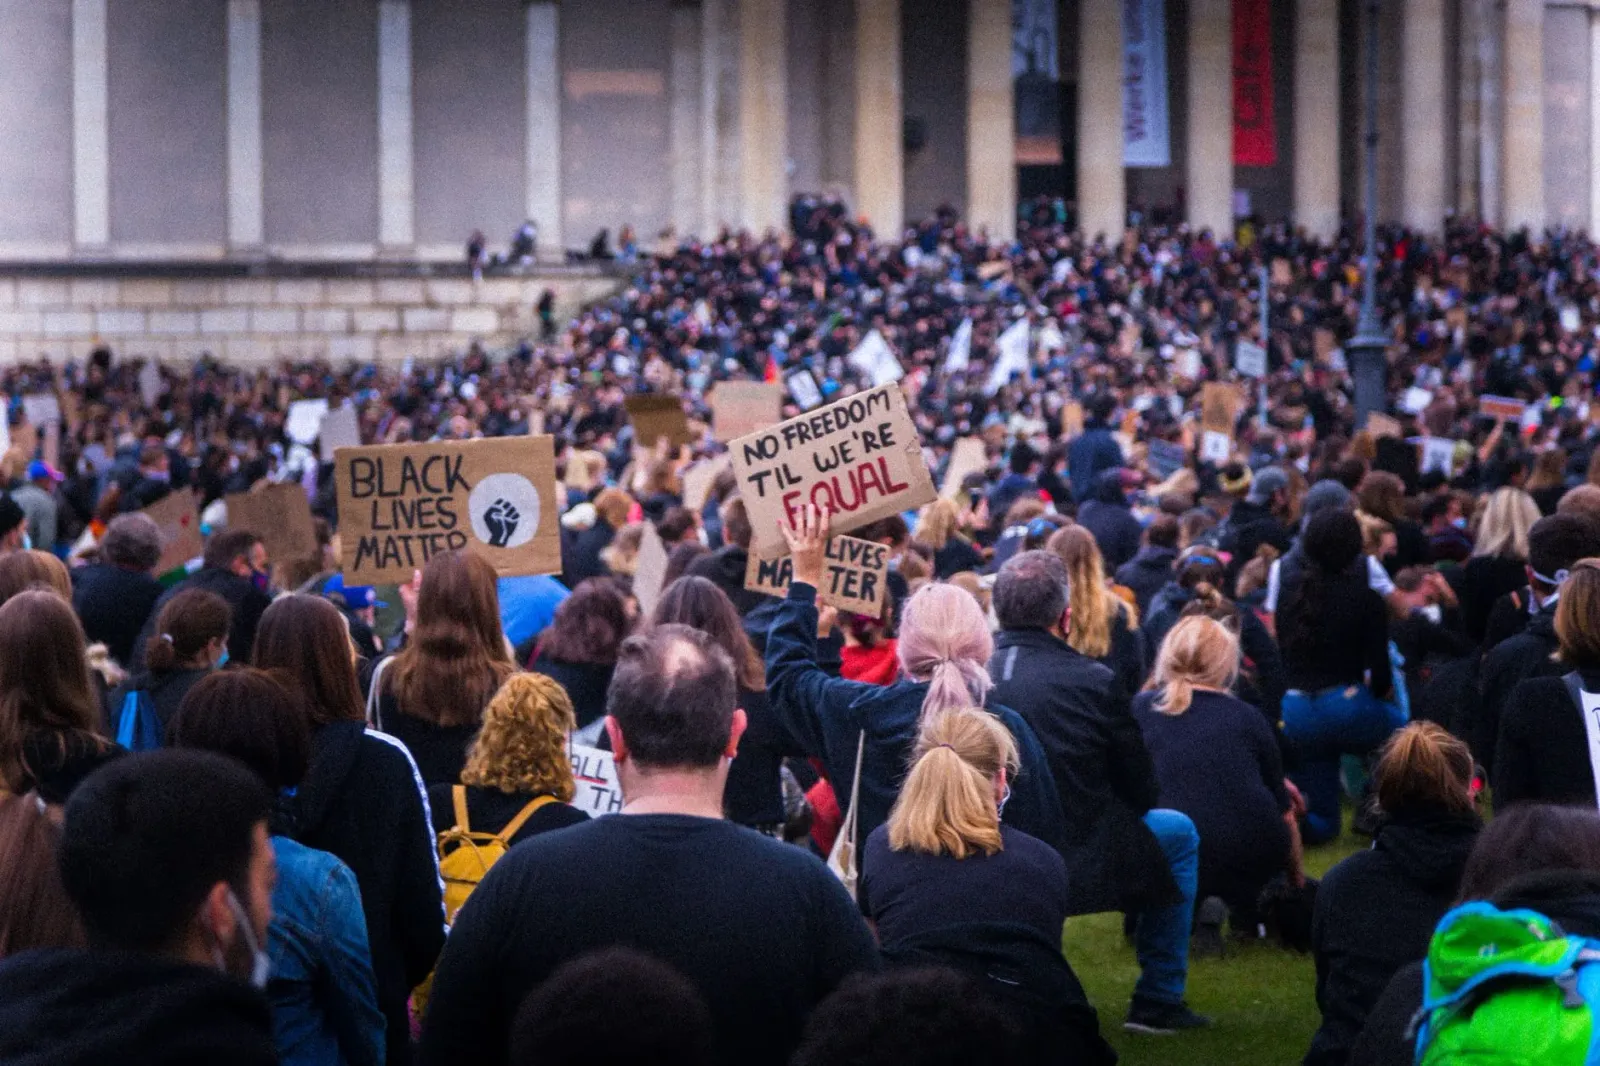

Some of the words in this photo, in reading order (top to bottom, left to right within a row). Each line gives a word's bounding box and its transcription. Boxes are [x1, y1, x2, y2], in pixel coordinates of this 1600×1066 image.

[744, 435, 779, 465] NO
[781, 390, 890, 449] FREEDOM
[350, 454, 471, 498] BLACK
[748, 463, 802, 496] TIL
[813, 422, 896, 473] WE'RE
[371, 497, 457, 530] LIVES
[825, 538, 886, 570] LIVES
